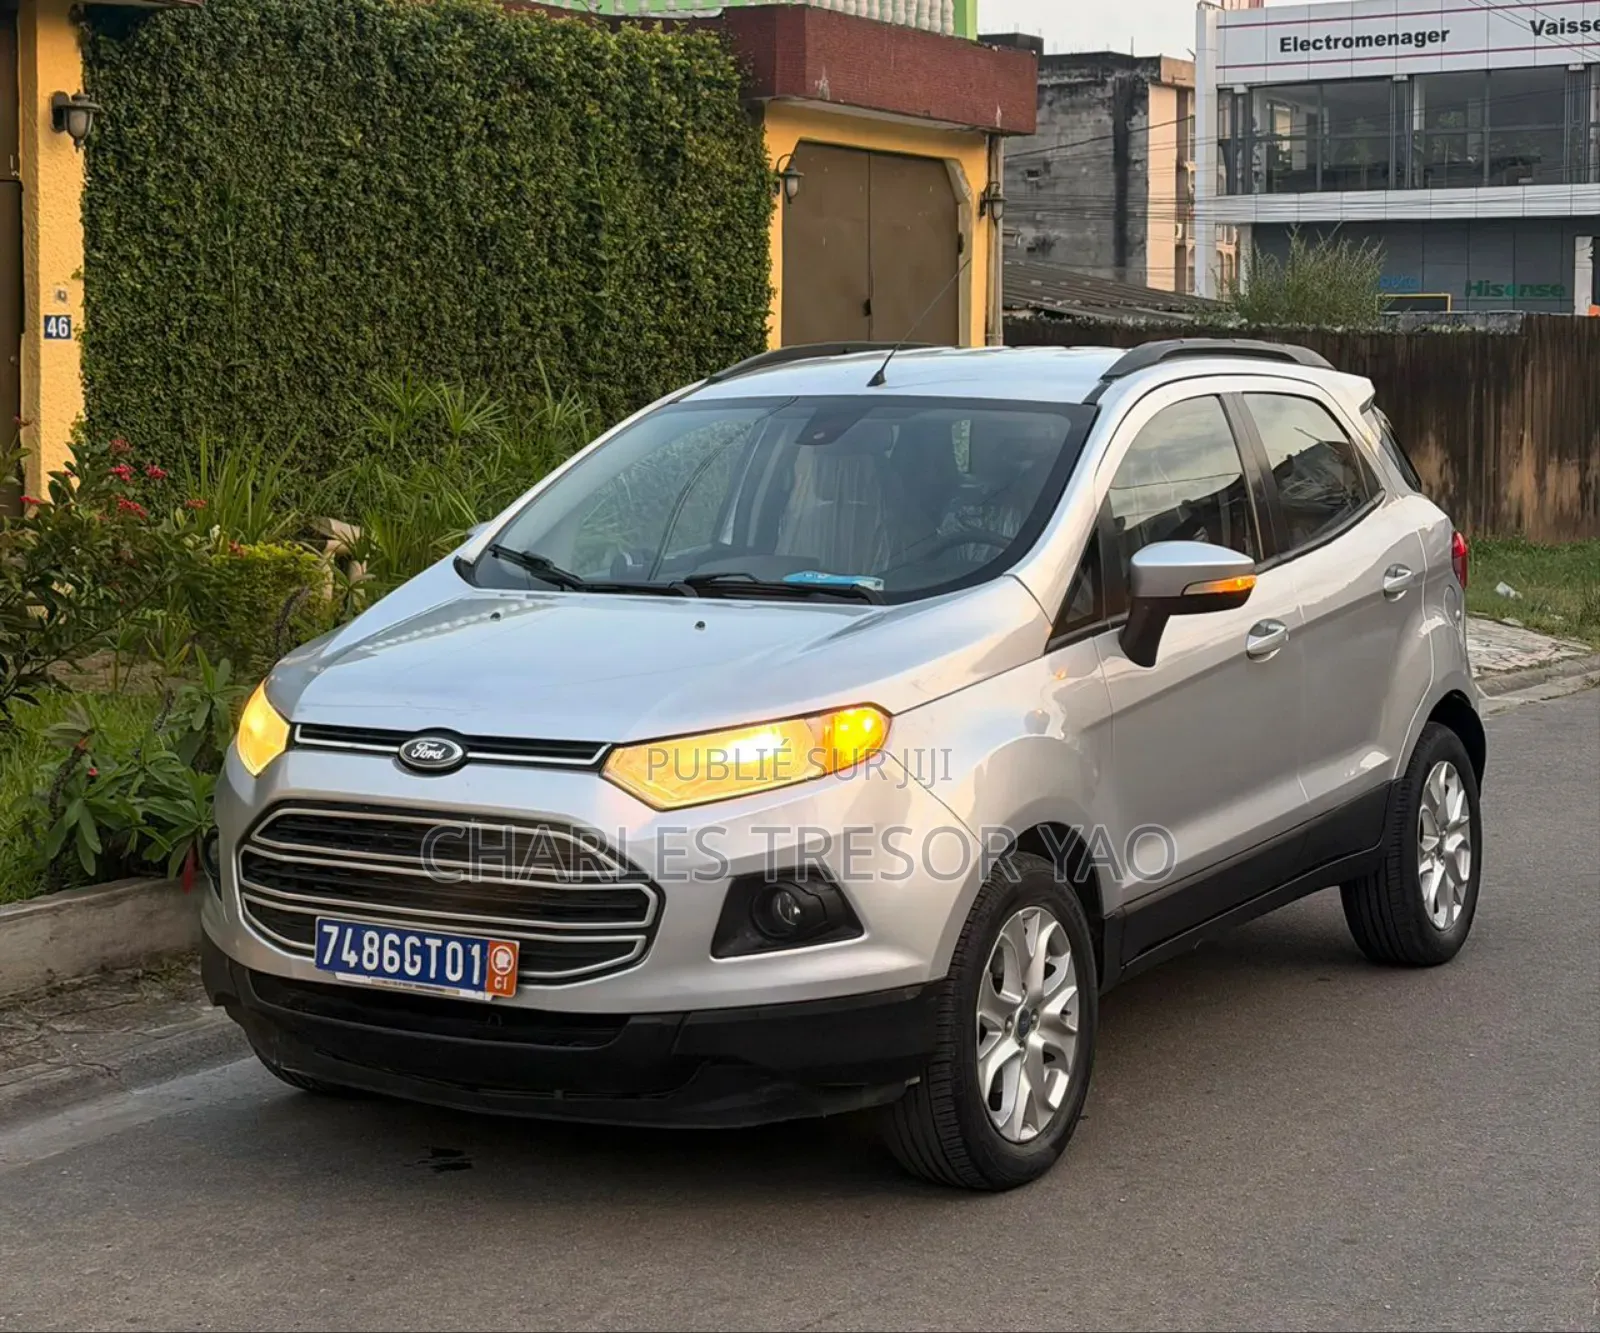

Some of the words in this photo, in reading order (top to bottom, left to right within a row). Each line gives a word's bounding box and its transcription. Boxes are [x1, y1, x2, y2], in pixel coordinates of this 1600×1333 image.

[1279, 29, 1450, 52] Electromenager
[1464, 279, 1566, 297] Hisense
[47, 316, 69, 337] 46
[411, 741, 446, 759] Ford
[321, 924, 481, 985] 7486GT01
[494, 976, 507, 990] CI
